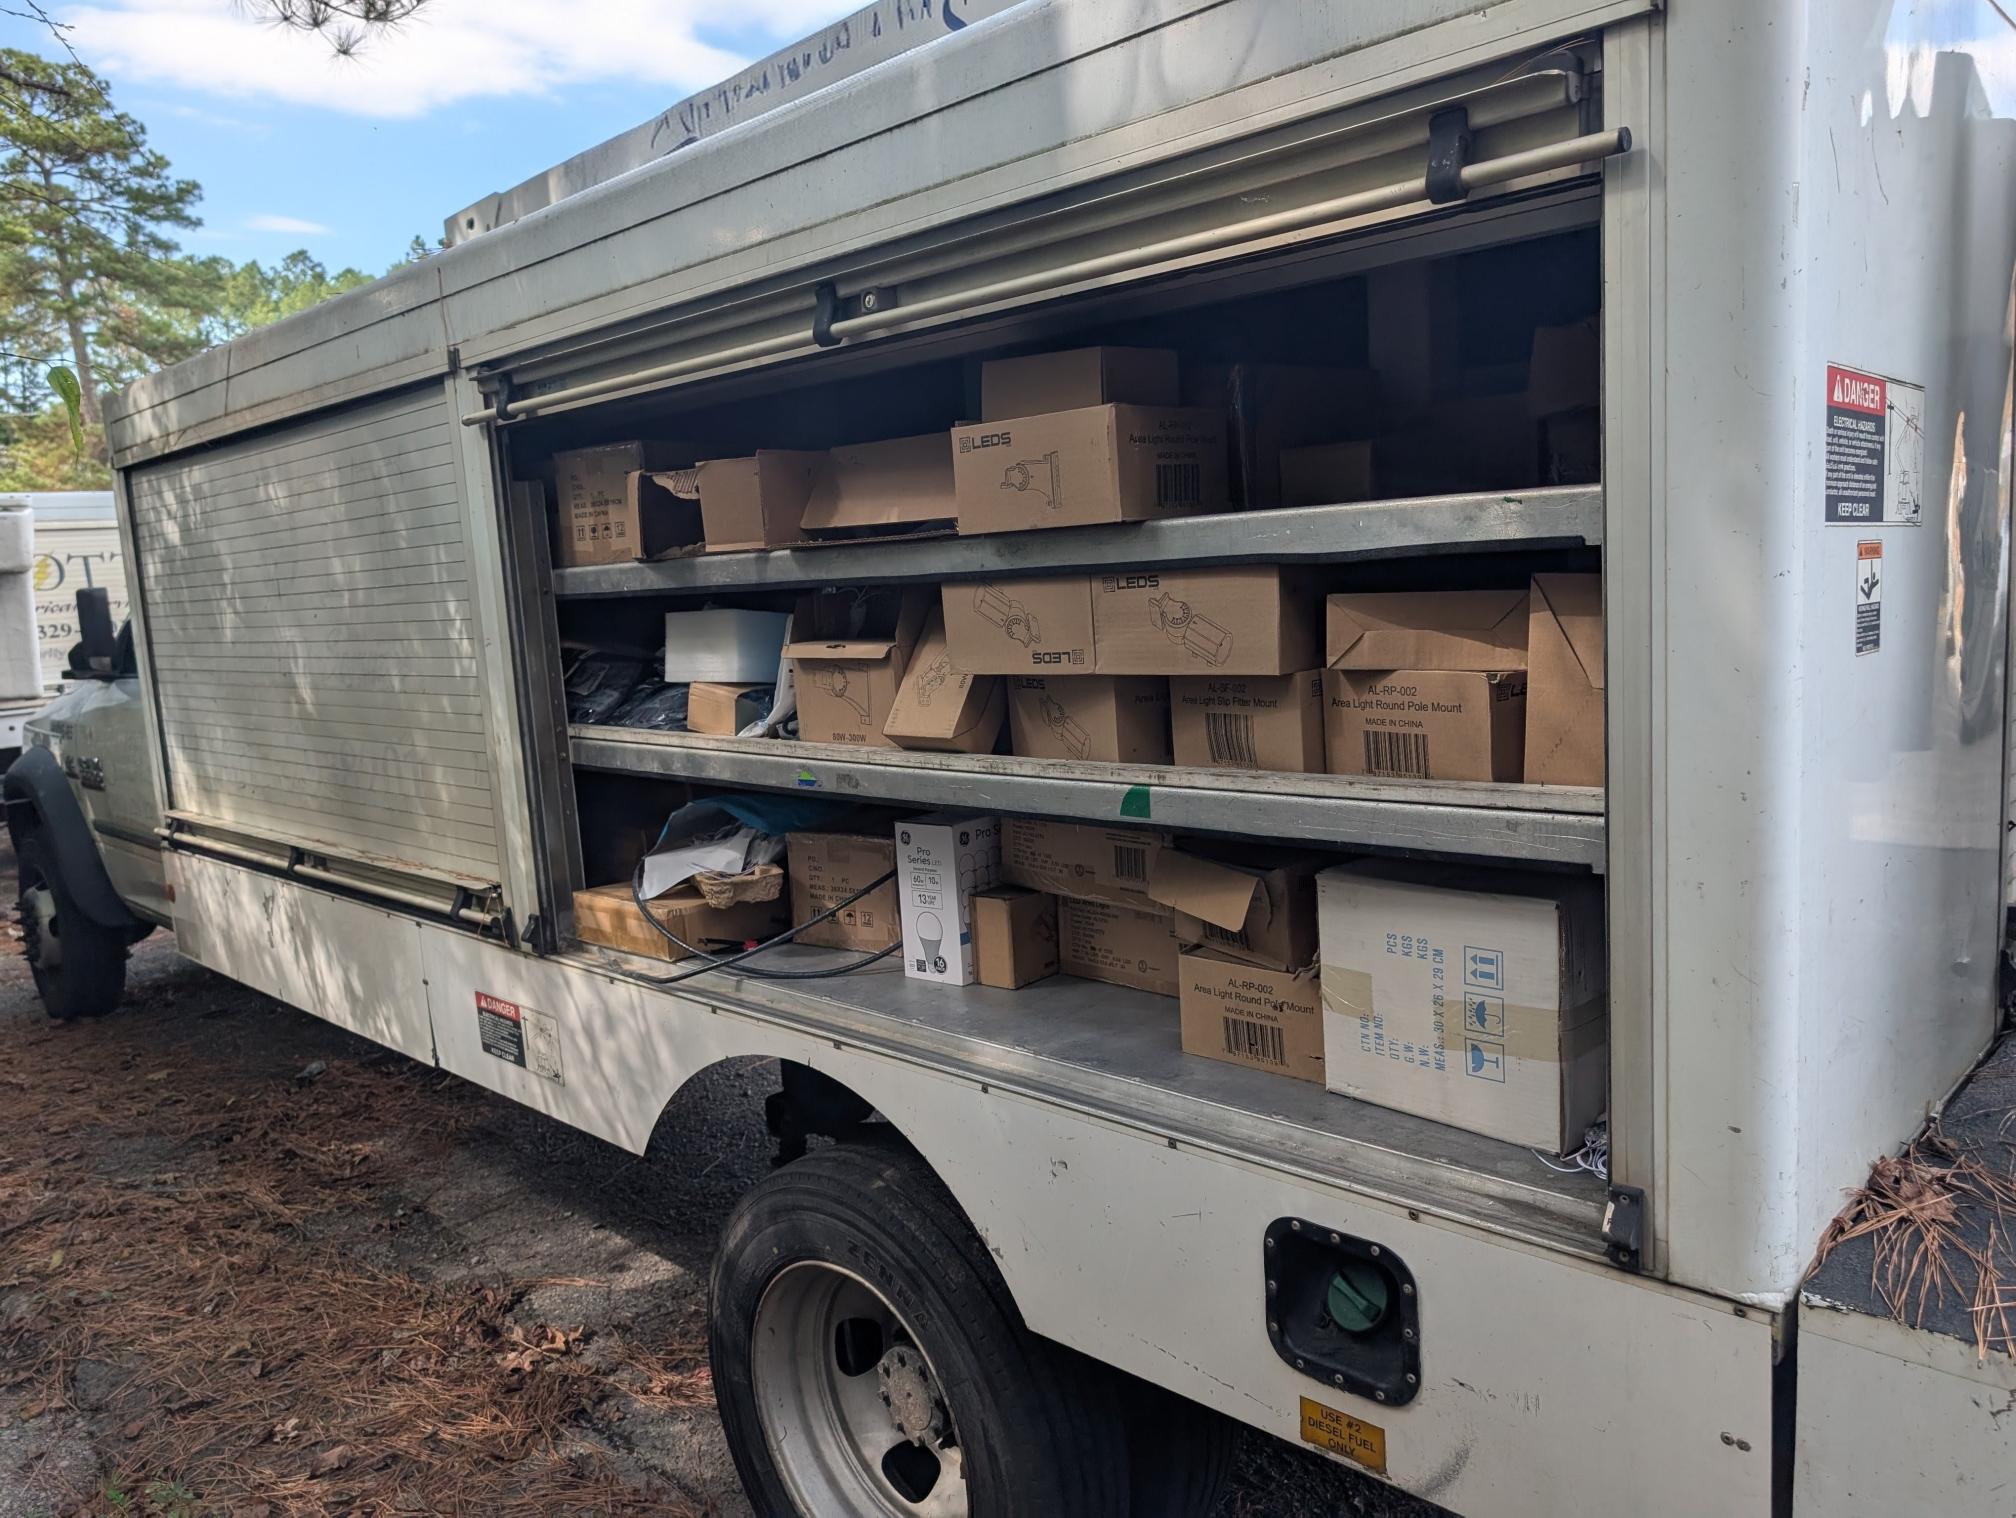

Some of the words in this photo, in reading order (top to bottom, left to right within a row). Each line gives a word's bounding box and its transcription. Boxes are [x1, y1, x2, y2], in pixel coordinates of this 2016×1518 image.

[1844, 378, 1880, 409] DANGER
[972, 432, 1011, 449] LEDS
[1838, 503, 1851, 516] KEEP
[1853, 503, 1870, 517] CLEAR
[1116, 574, 1160, 590] LEDS
[1032, 651, 1071, 665] LEDS
[1021, 678, 1045, 690] LEDS
[1368, 685, 1417, 697] AL-RP-002
[1182, 695, 1196, 705] Area
[1197, 696, 1217, 707] Light
[1217, 696, 1231, 707] Slip
[1232, 696, 1251, 707] Fitter
[1253, 698, 1278, 709] Mount
[1331, 698, 1351, 708] Area
[1353, 700, 1373, 711] Light
[1376, 701, 1405, 711] Round
[1407, 702, 1429, 712] Pole
[1431, 703, 1463, 714] Mount
[1365, 717, 1387, 727] MADE
[1389, 719, 1397, 727] IN
[1398, 719, 1424, 729] CHINA
[975, 828, 991, 841] Pro
[917, 847, 931, 857] Pro
[908, 855, 931, 866] Series
[809, 892, 826, 900] MADE
[917, 894, 927, 905] 13
[1387, 932, 1397, 954] PCS
[1402, 935, 1413, 957] KGS
[1417, 937, 1428, 960] KGS
[935, 957, 944, 968] 16
[1433, 948, 1444, 964] CM
[1433, 967, 1444, 980] 29
[1228, 978, 1274, 995] AL-RP-002
[1433, 983, 1444, 991] X
[1193, 983, 1212, 995] Area
[1213, 988, 1233, 1001] Light
[1235, 992, 1262, 1006] Round
[1286, 1002, 1315, 1015] Mount
[1433, 994, 1444, 1007] 26
[487, 998, 515, 1018] DANGER
[1225, 1005, 1245, 1017] MADE
[1246, 1009, 1254, 1018] IN
[1255, 1012, 1279, 1023] CHINA
[1433, 1010, 1444, 1018] X
[1360, 1012, 1370, 1029] NO:
[1373, 1012, 1384, 1030] NO:
[1434, 1021, 1444, 1032] 30
[1361, 1030, 1371, 1052] CTN
[1374, 1031, 1385, 1056] ITEM
[1389, 1037, 1400, 1060] QTY:
[1403, 1041, 1414, 1063] G.W:
[1418, 1044, 1430, 1067] N.W:
[1321, 1408, 1343, 1426] USE
[1346, 1420, 1362, 1435] #2
[1308, 1416, 1345, 1440] DIESEL
[1348, 1433, 1376, 1453] FUEL
[1328, 1438, 1356, 1457] ONLY
